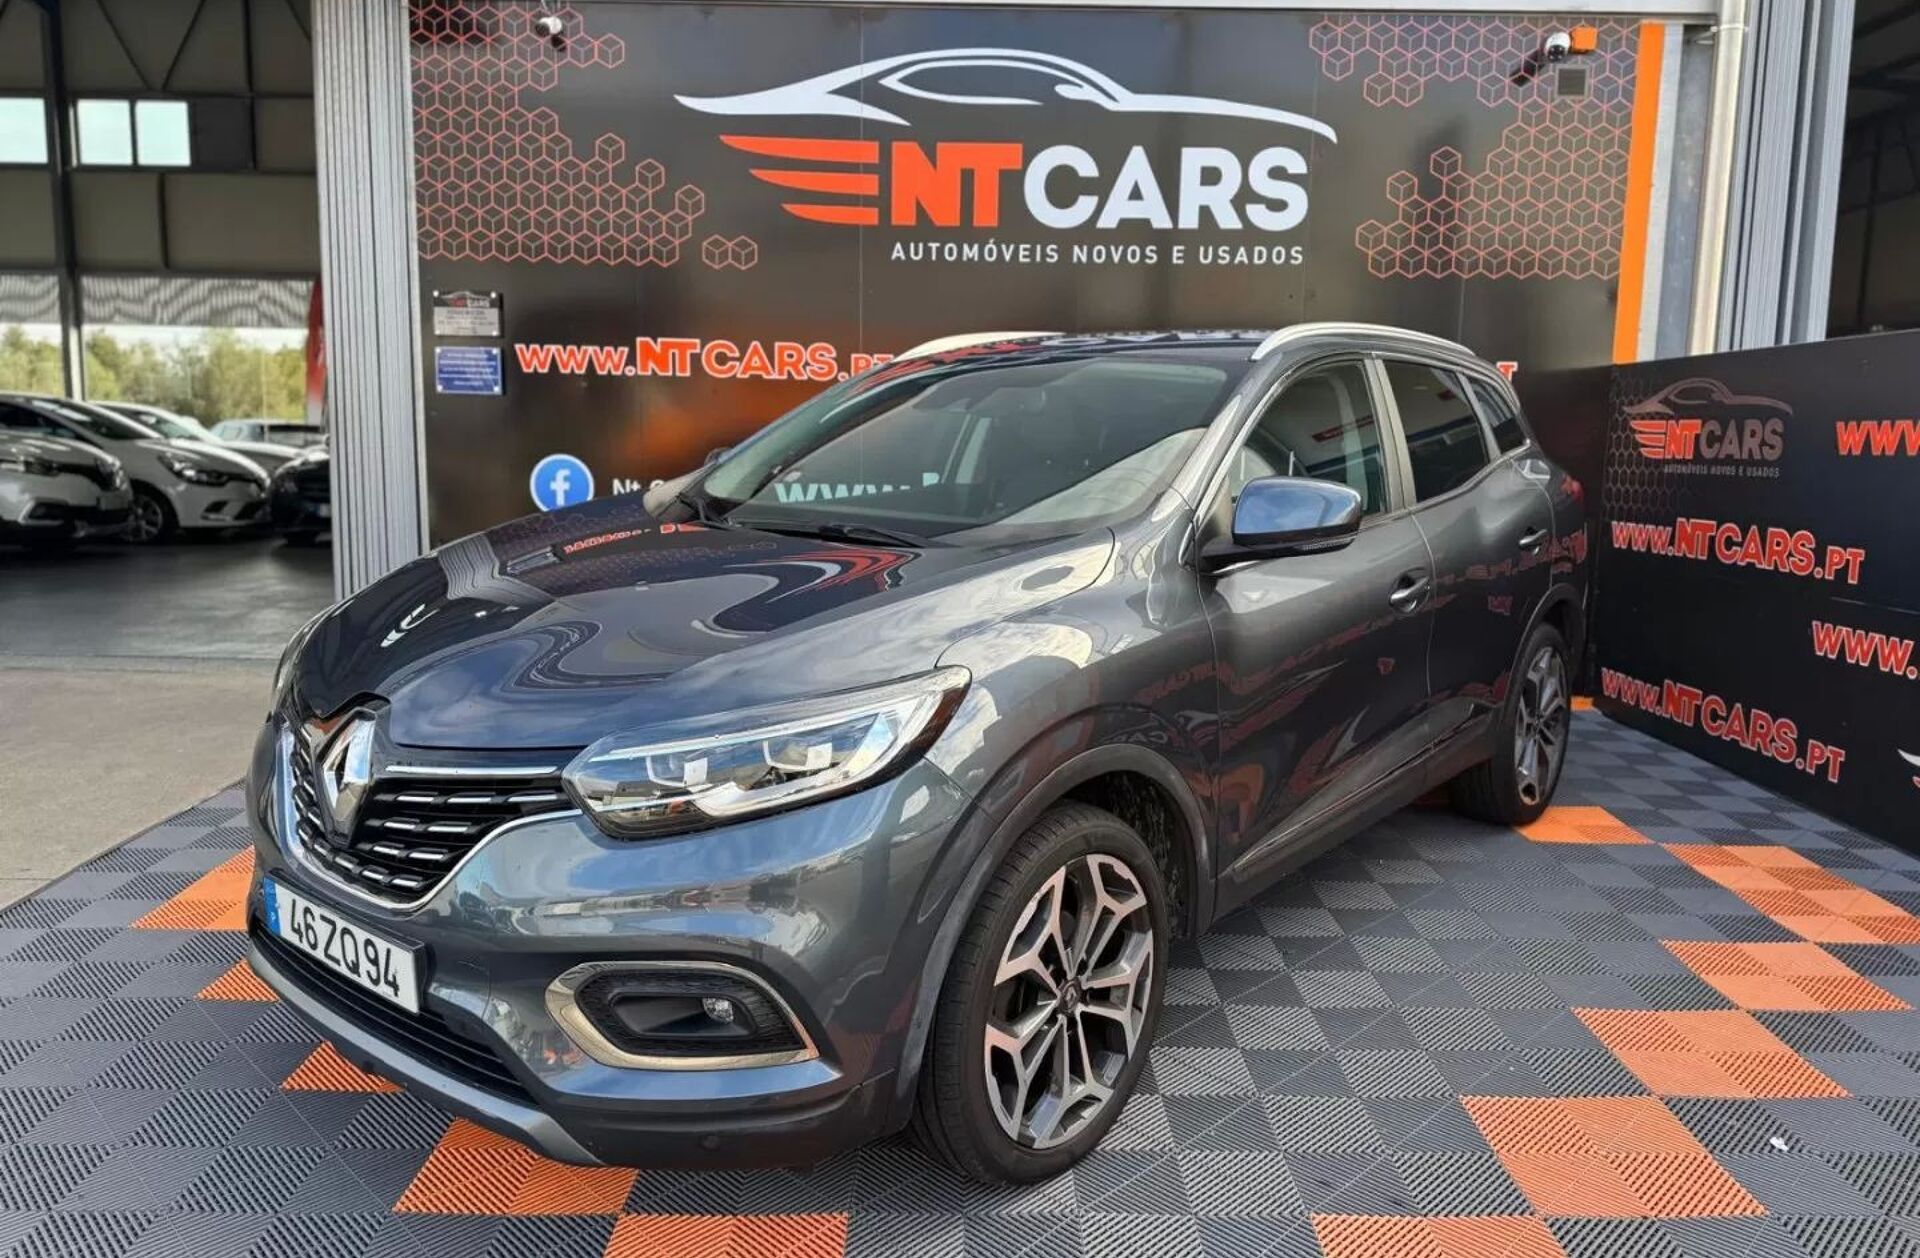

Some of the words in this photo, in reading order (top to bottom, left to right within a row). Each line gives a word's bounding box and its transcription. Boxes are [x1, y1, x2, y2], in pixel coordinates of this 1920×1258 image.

[891, 238, 1059, 263] AUTOMÓVEIS
[1073, 244, 1158, 264] NOVOS
[1172, 245, 1185, 264] E
[1200, 245, 1303, 264] USADOS
